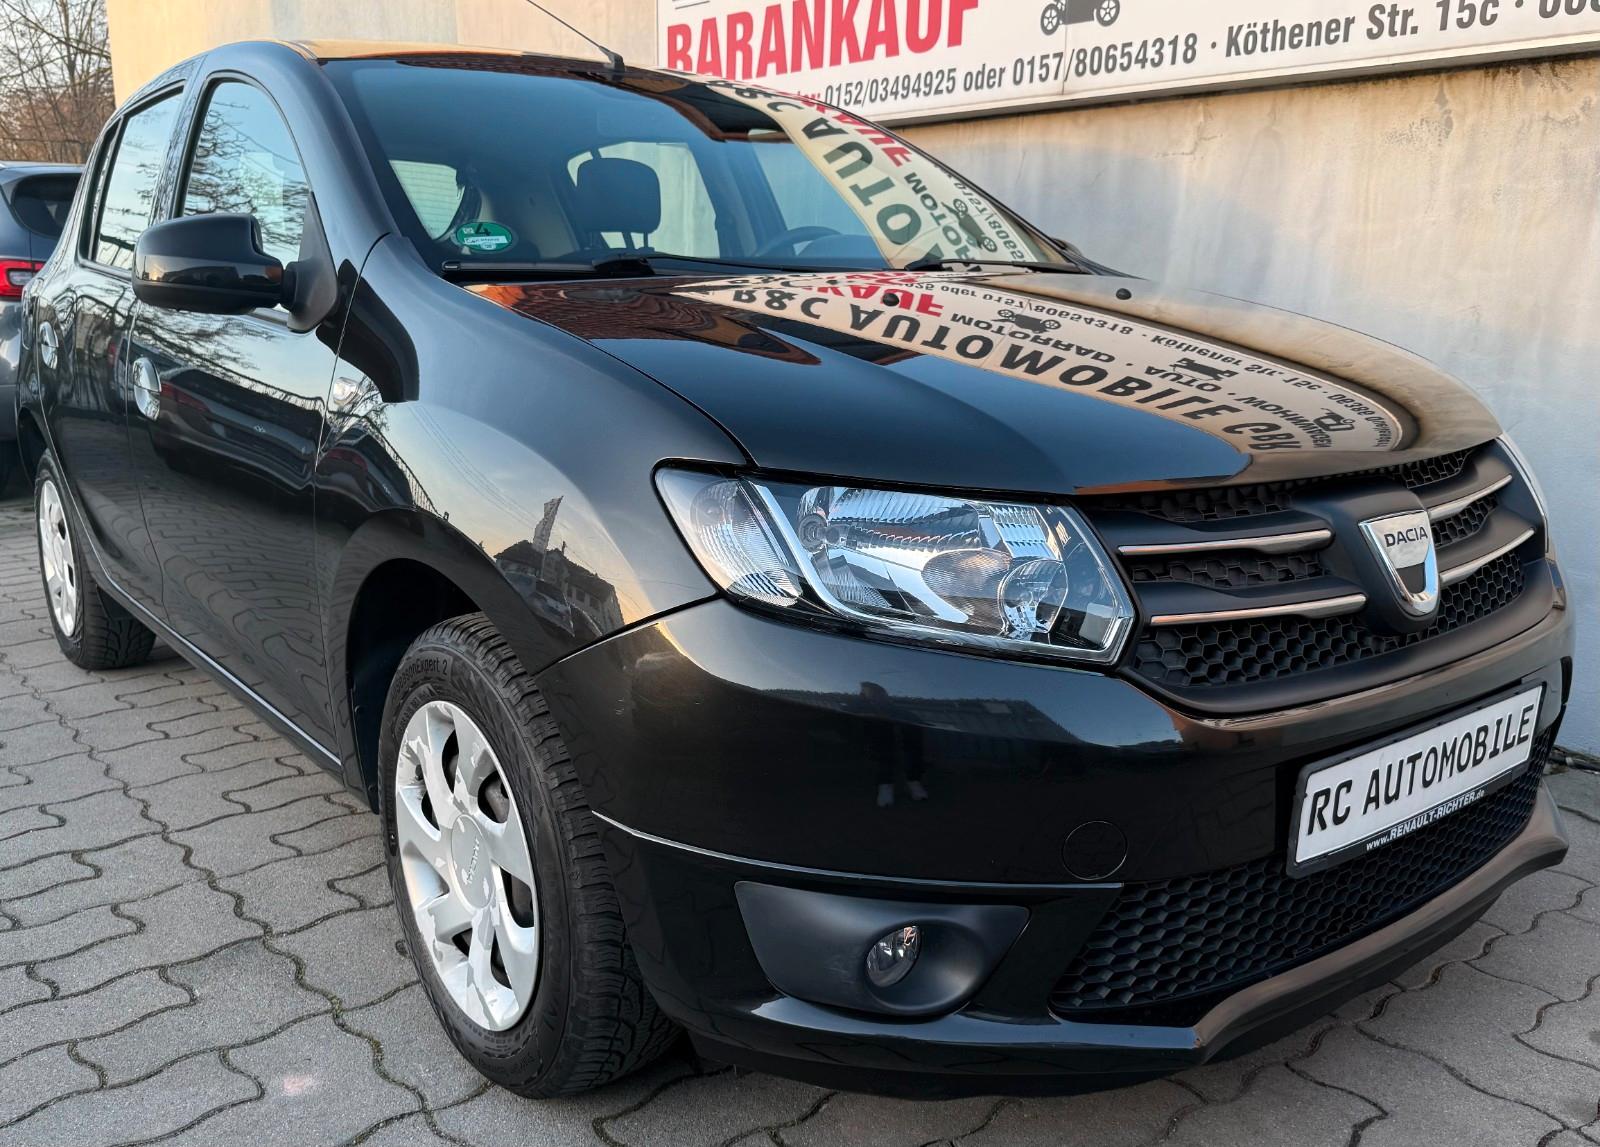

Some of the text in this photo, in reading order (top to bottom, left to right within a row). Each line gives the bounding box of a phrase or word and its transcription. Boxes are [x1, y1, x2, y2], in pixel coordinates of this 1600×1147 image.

[825, 66, 957, 108] 0152/03494925
[963, 64, 1006, 92] oder
[1012, 32, 1198, 87] 0157/80654318
[1225, 15, 1355, 58] Köthener
[1366, 3, 1419, 41] Str.
[1437, 0, 1499, 31] 15c
[1384, 526, 1429, 548] DACIA
[1307, 703, 1535, 836] RC AUTOMOBILE
[1366, 789, 1485, 852] www.RENAULT-RICHTER.de
